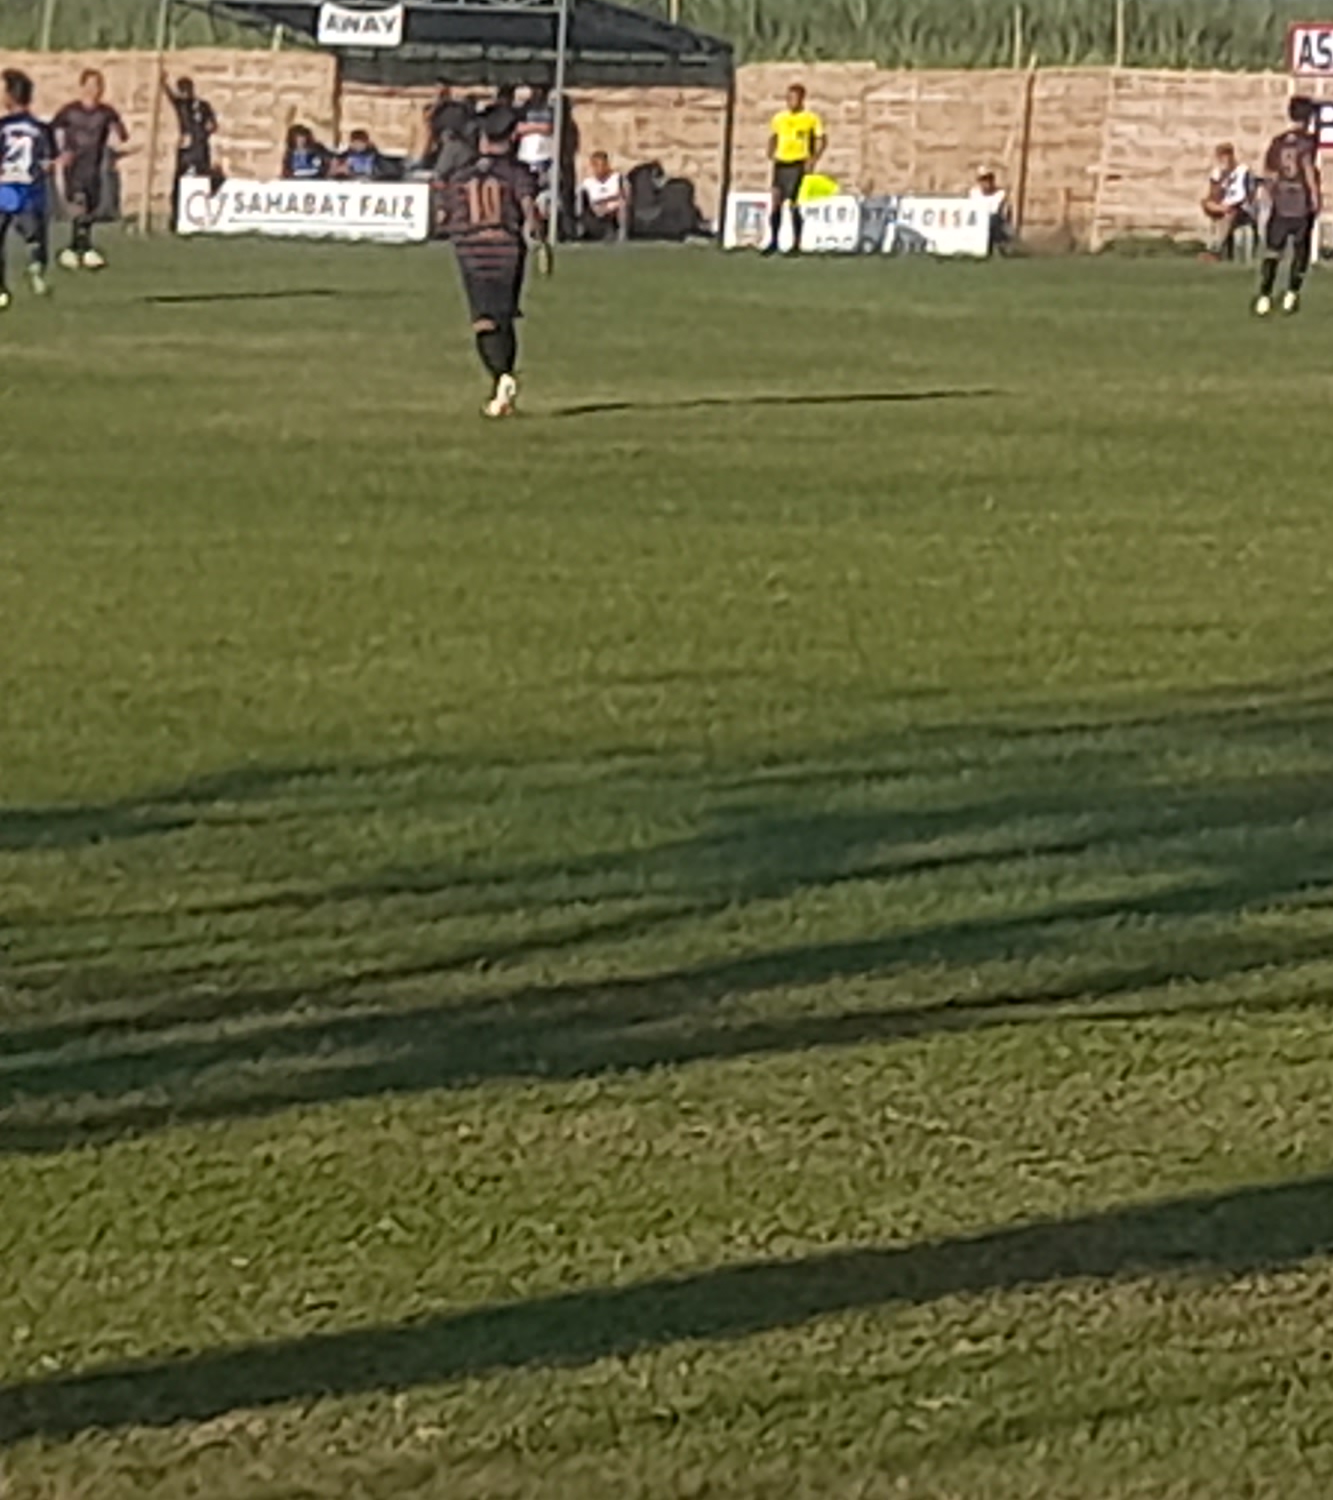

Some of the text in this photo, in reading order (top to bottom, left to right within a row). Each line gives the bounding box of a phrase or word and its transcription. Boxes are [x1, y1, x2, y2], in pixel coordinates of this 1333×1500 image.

[325, 12, 398, 33] AWAY
[233, 191, 351, 217] SAHABAT
[360, 195, 415, 220] FAIZ
[466, 178, 502, 225] 10
